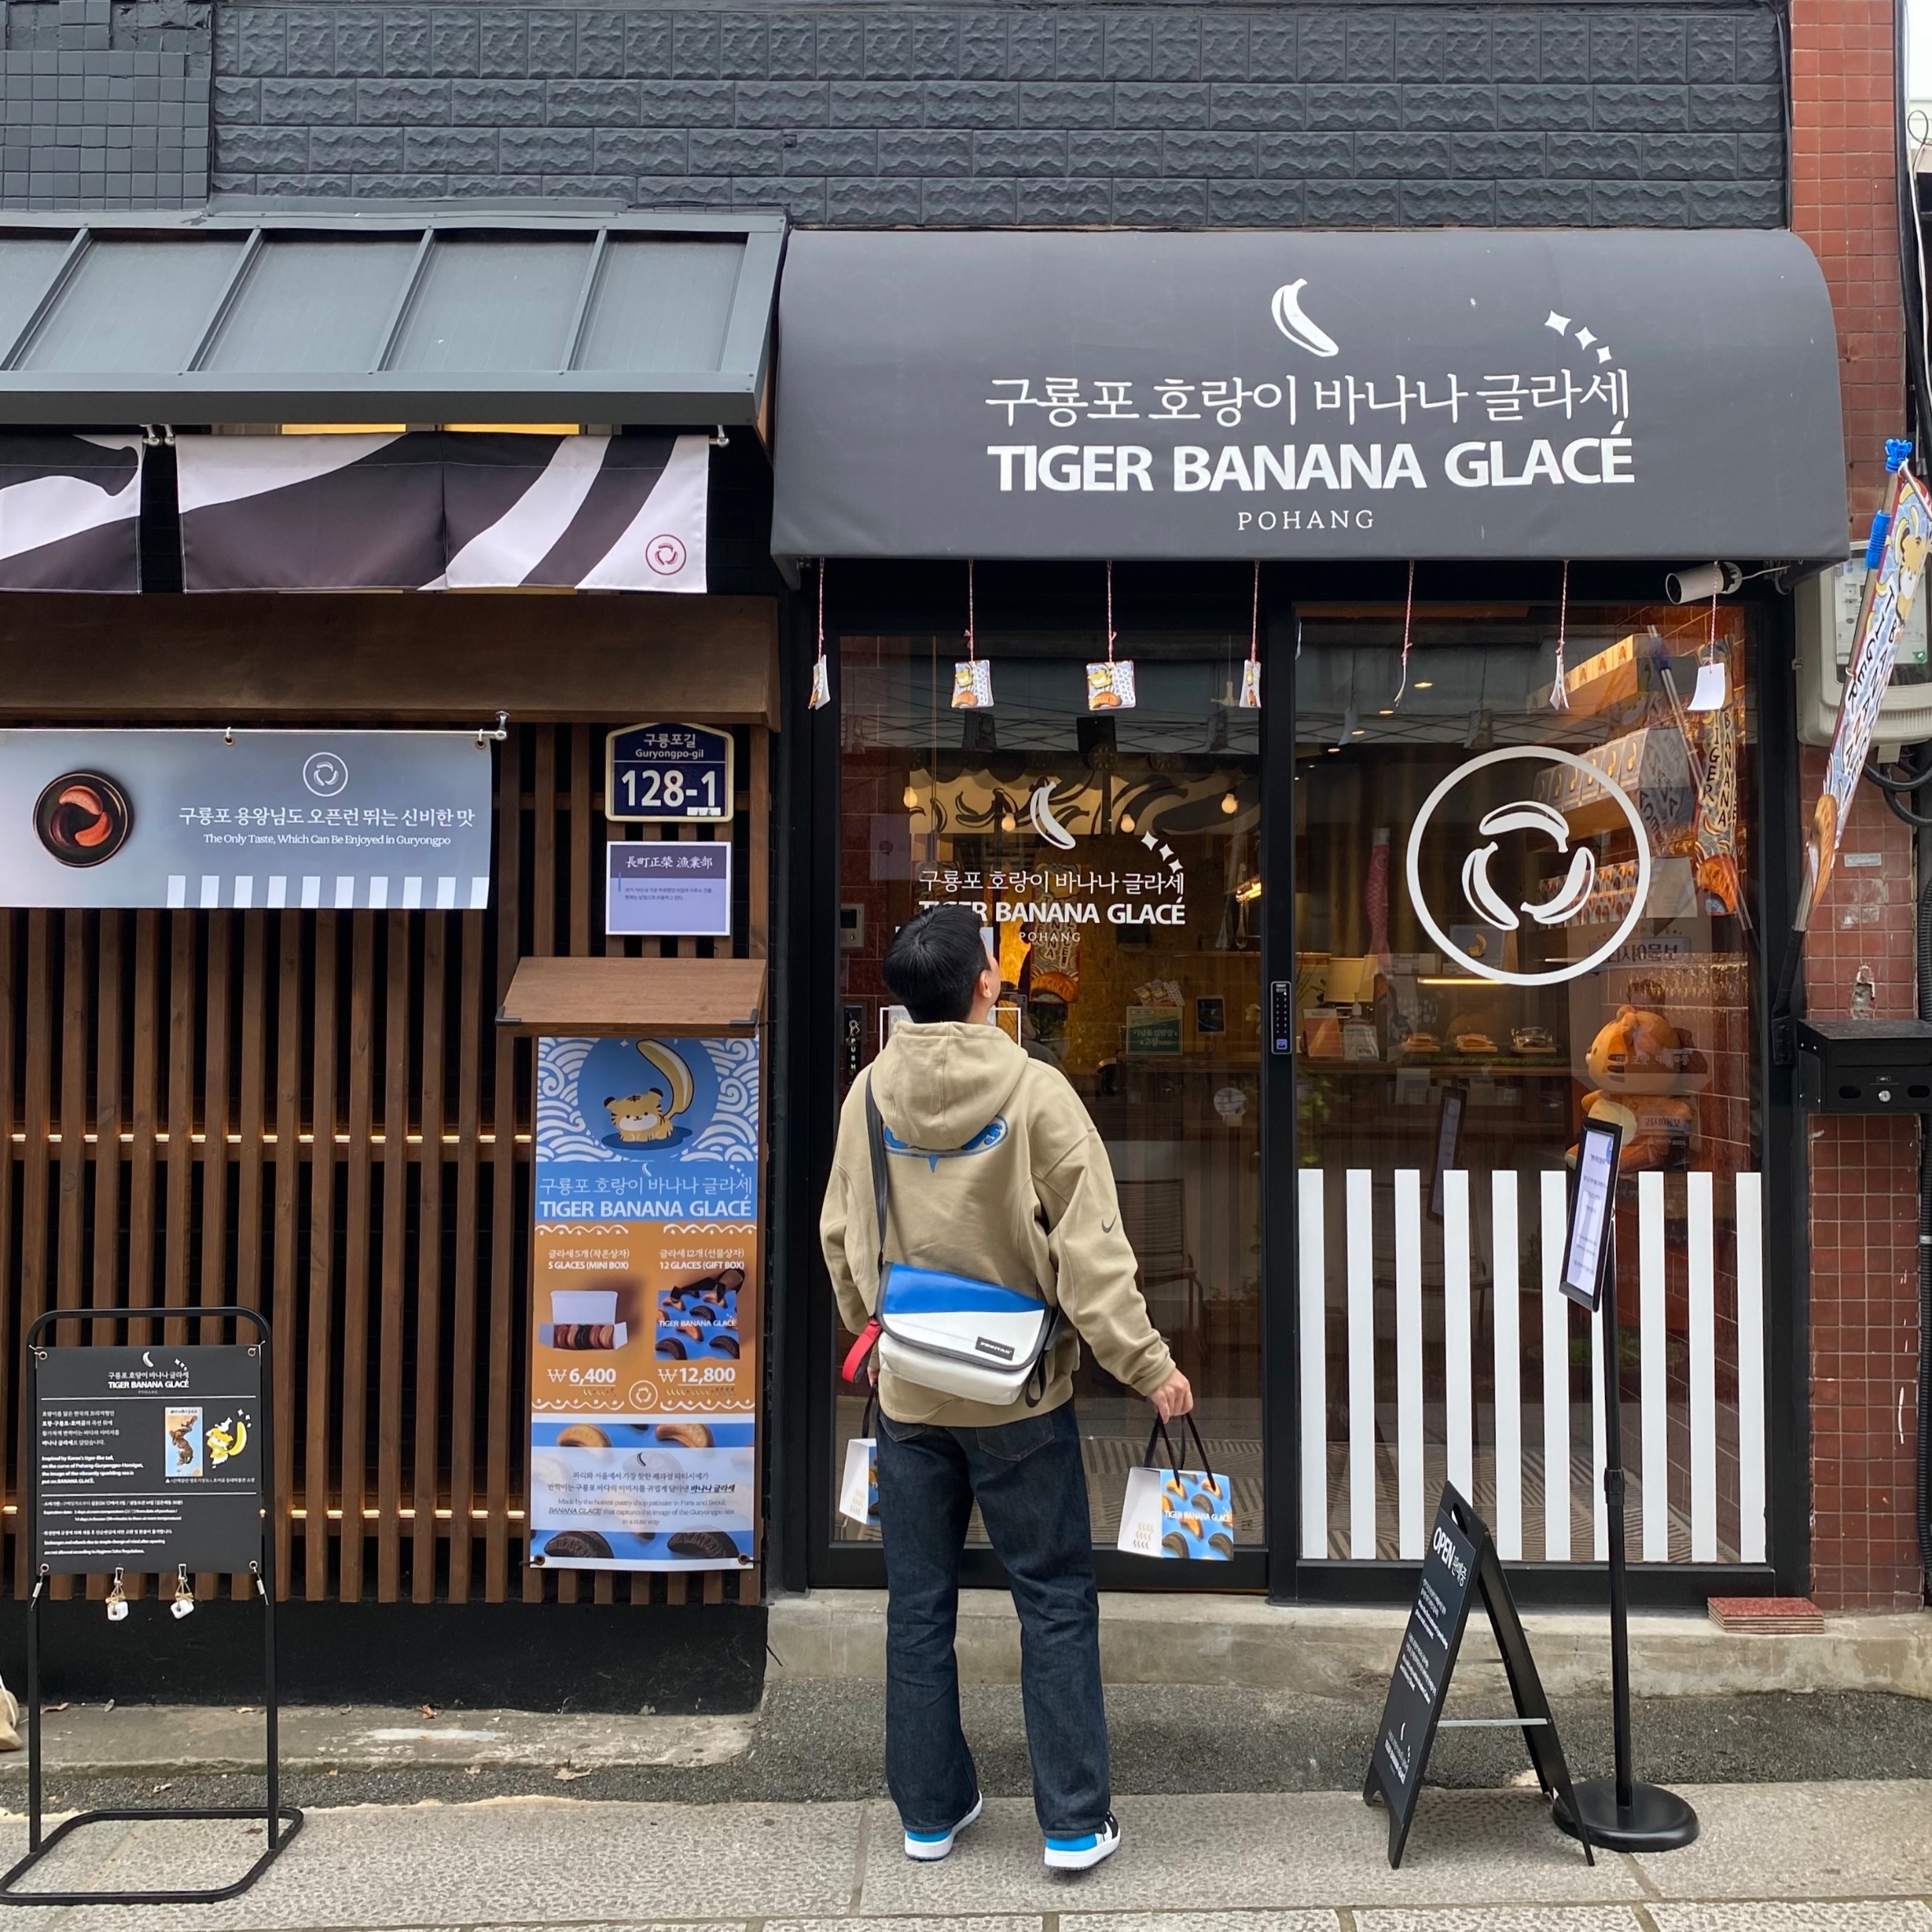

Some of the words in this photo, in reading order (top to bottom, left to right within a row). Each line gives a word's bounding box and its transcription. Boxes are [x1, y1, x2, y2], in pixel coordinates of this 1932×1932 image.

[984, 375, 1140, 426] 구룡포
[1148, 375, 1296, 425] 호랑이
[1314, 373, 1469, 425] 바나나
[1476, 368, 1630, 421] 글라세
[987, 443, 1154, 492] TIGER
[1173, 443, 1427, 492] BANANA
[1444, 421, 1634, 487] GLACÉ
[1238, 509, 1375, 531] POHANG
[643, 734, 696, 748] 구룡포길
[635, 749, 704, 759] Guryongpo-gil
[621, 770, 716, 807] 128-1
[179, 807, 232, 825] 구룡포
[234, 807, 305, 826] 용왕님도
[307, 807, 359, 826] 오픈런
[362, 807, 398, 826] 뛰는
[401, 808, 454, 827] 신비한
[457, 808, 475, 827] 맛
[203, 834, 222, 843] The
[224, 834, 247, 846] Only
[248, 834, 276, 845] Taste,
[277, 834, 309, 844] Which
[311, 834, 330, 844] Can
[331, 835, 343, 844] Be
[345, 835, 384, 847] Enjoyed
[385, 835, 395, 844] in
[396, 835, 451, 848] Guryongpo
[919, 871, 983, 892] 구룡포
[987, 871, 1048, 893] 호랑이
[1055, 871, 1119, 894] 바나나
[1122, 871, 1184, 895] 글라세
[996, 902, 1100, 923] BANANA
[1107, 897, 1185, 925] GLACÉ
[1019, 931, 1080, 943] POHANG
[539, 1178, 589, 1196] 구룡포
[593, 1177, 643, 1195] 호랑이
[648, 1177, 699, 1194] 바나나
[702, 1177, 752, 1195] 글라세
[539, 1201, 594, 1217] TIGER
[600, 1201, 684, 1216] BANANA
[689, 1194, 752, 1216] GLACÉ
[586, 1261, 607, 1270] (MINI
[609, 1261, 629, 1270] BOX)
[702, 1261, 724, 1270] (GIFT
[725, 1261, 744, 1270] BOX)
[165, 1378, 189, 1388] GLACÉ
[1434, 1526, 1456, 1569] OPEN
